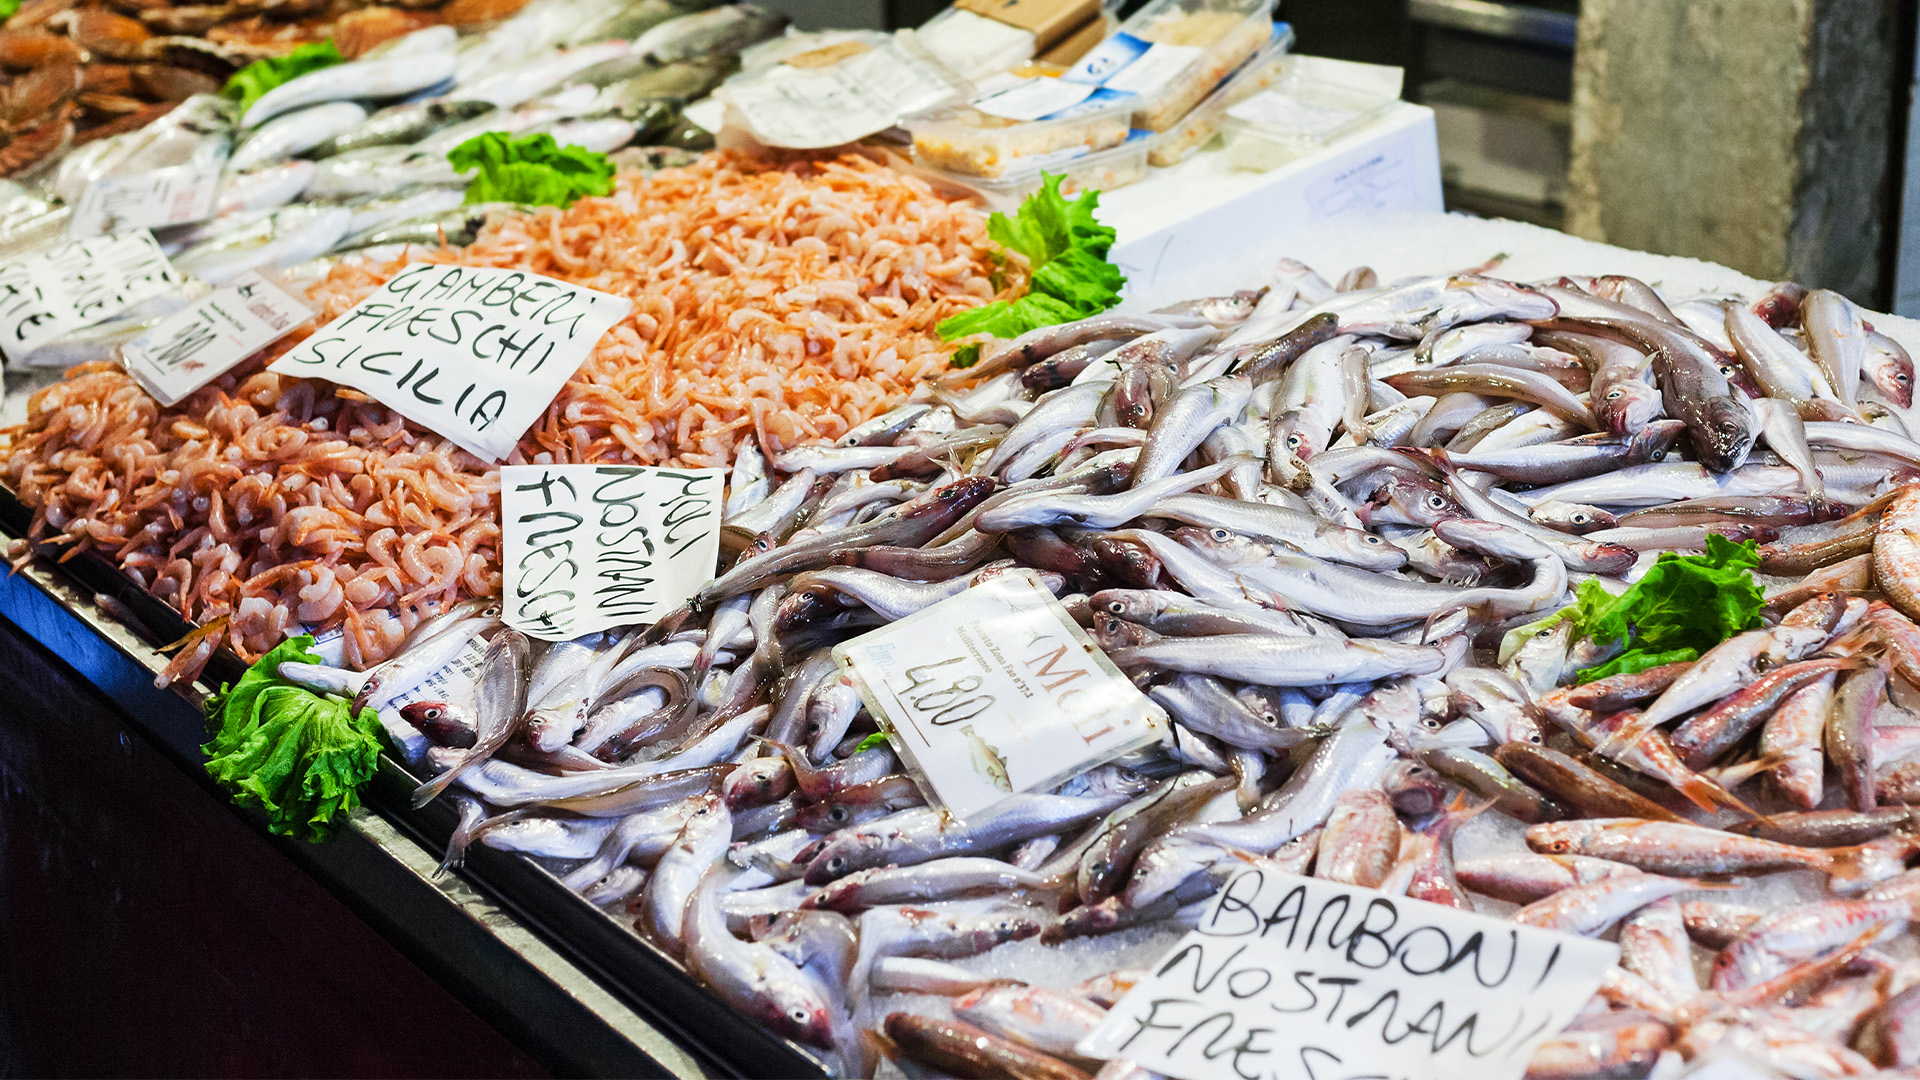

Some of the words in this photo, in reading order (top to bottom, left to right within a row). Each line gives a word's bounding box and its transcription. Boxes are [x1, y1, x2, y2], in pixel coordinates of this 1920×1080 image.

[293, 338, 507, 431] SICILIA
[337, 303, 555, 376] FRESCHI
[515, 471, 584, 636] FRESCHI
[592, 467, 658, 617] NOSTRANI
[897, 656, 997, 726] 4.80
[955, 625, 993, 674] Mediterraneo
[989, 646, 1007, 666] Zona
[1003, 664, 1017, 678] Fao
[1197, 868, 1563, 994] BARBONI
[1156, 944, 1552, 1058] NOSTRANI
